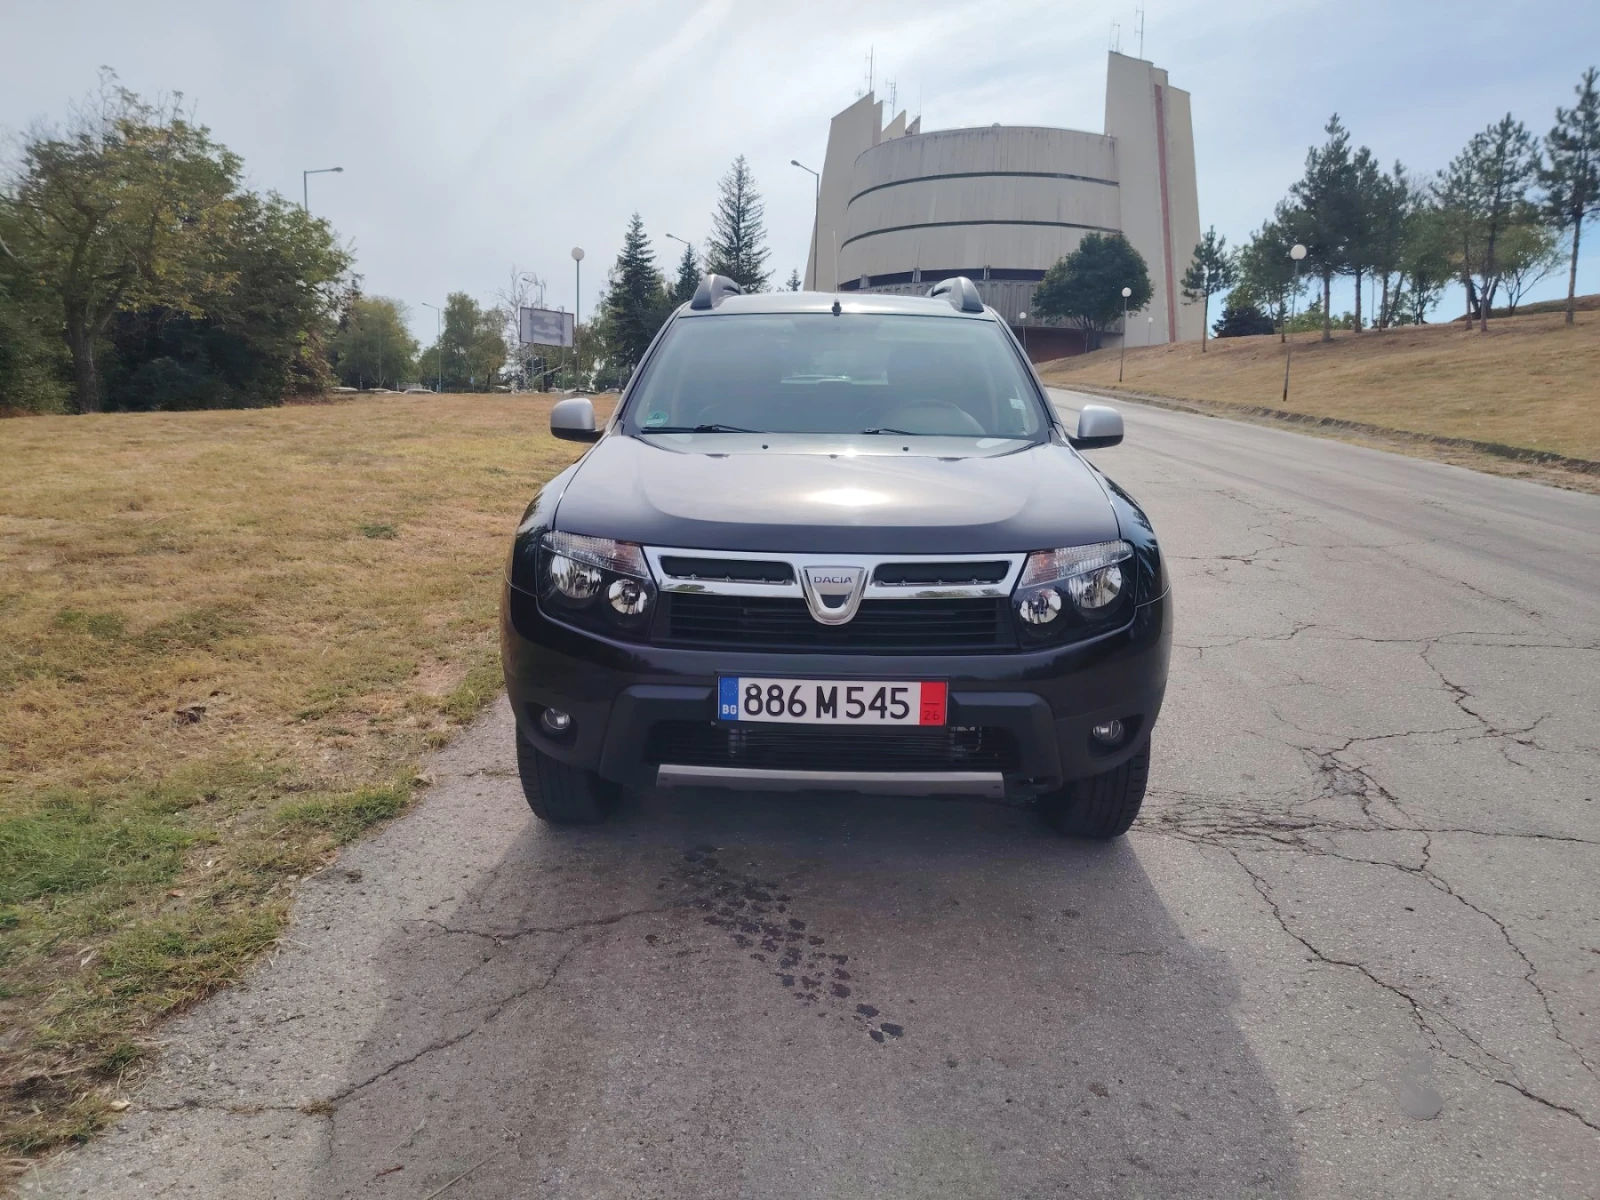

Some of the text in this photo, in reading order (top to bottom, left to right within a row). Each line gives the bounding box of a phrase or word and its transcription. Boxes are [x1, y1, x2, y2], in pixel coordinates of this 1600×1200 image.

[814, 576, 853, 584] DACIA
[743, 683, 807, 717] 886
[722, 704, 737, 715] BG
[924, 710, 940, 721] 26
